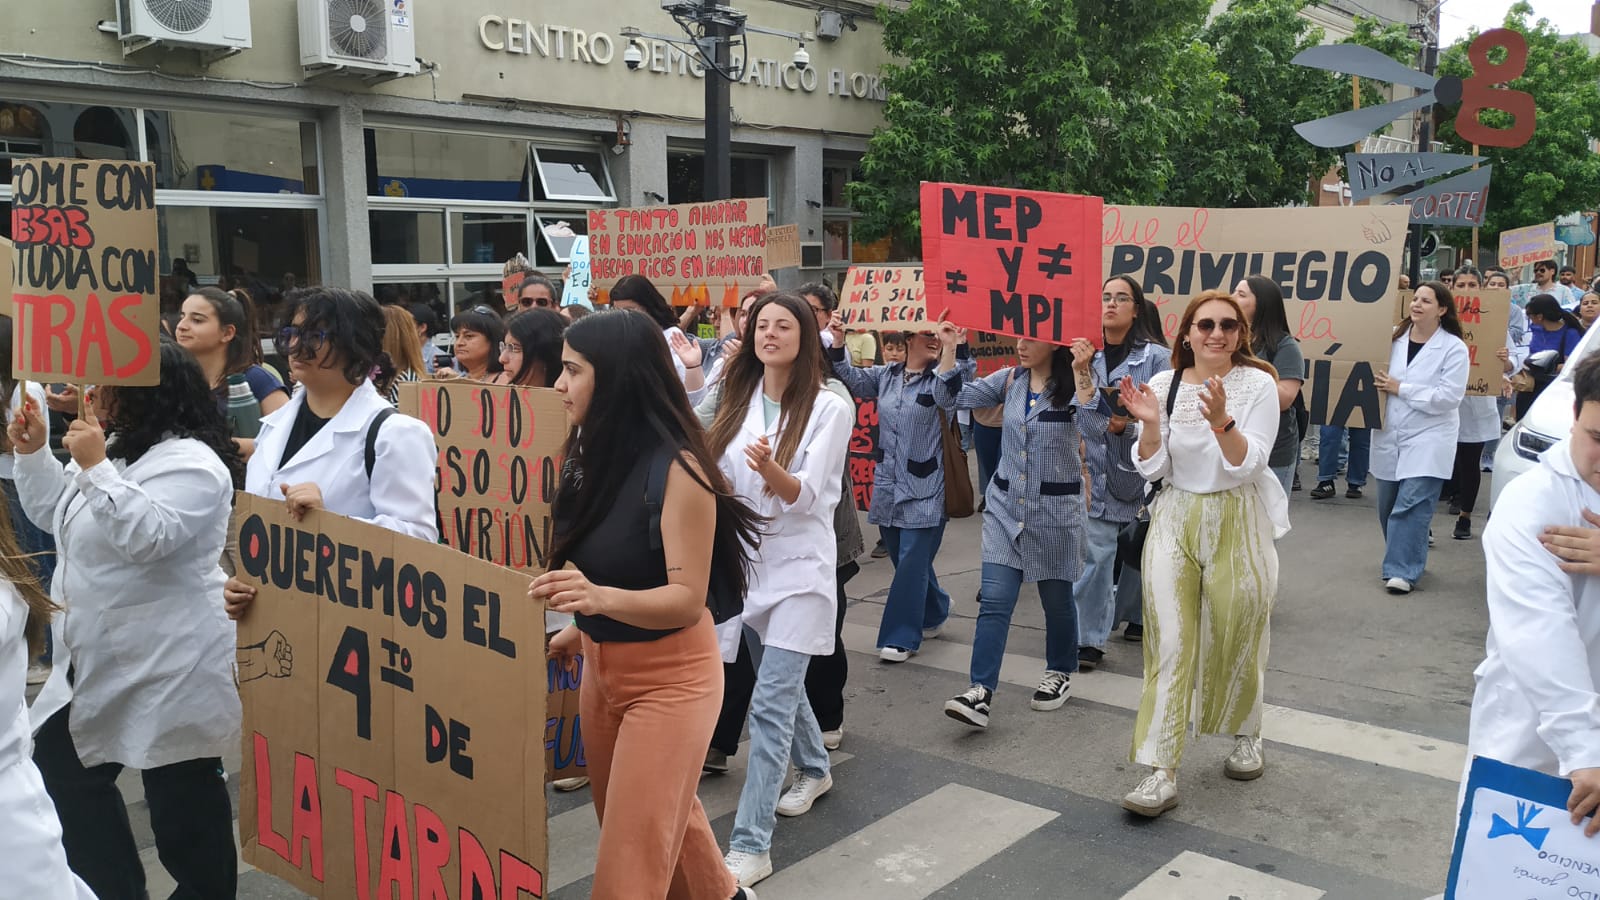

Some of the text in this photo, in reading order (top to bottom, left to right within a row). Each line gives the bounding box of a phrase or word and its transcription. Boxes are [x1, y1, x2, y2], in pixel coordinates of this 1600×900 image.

[478, 14, 614, 65] CENTRO
[624, 36, 818, 92] DEMORATICO
[97, 163, 155, 212] CON
[1402, 156, 1435, 178] AL
[589, 200, 748, 232] DE TANTO AHORRAR
[942, 187, 1043, 243] MEP
[1387, 185, 1489, 225] CORTE!
[590, 233, 611, 256] EN
[705, 228, 725, 251] NOS
[728, 223, 767, 249] HEMOS
[1174, 207, 1209, 251] el
[101, 247, 156, 295] CON
[590, 257, 634, 280] HECHO
[681, 254, 704, 279] EN
[853, 268, 902, 287] MENOS
[996, 246, 1024, 293] Y
[849, 285, 880, 304] MÁS
[858, 307, 875, 323] AL
[881, 305, 925, 323] RECOR
[989, 289, 1063, 343] MPI
[1295, 301, 1338, 341] la
[421, 386, 536, 450] NO SOMOS
[239, 513, 517, 659] QUEREMOS EL
[425, 703, 474, 780] DE
[253, 730, 324, 883] LA
